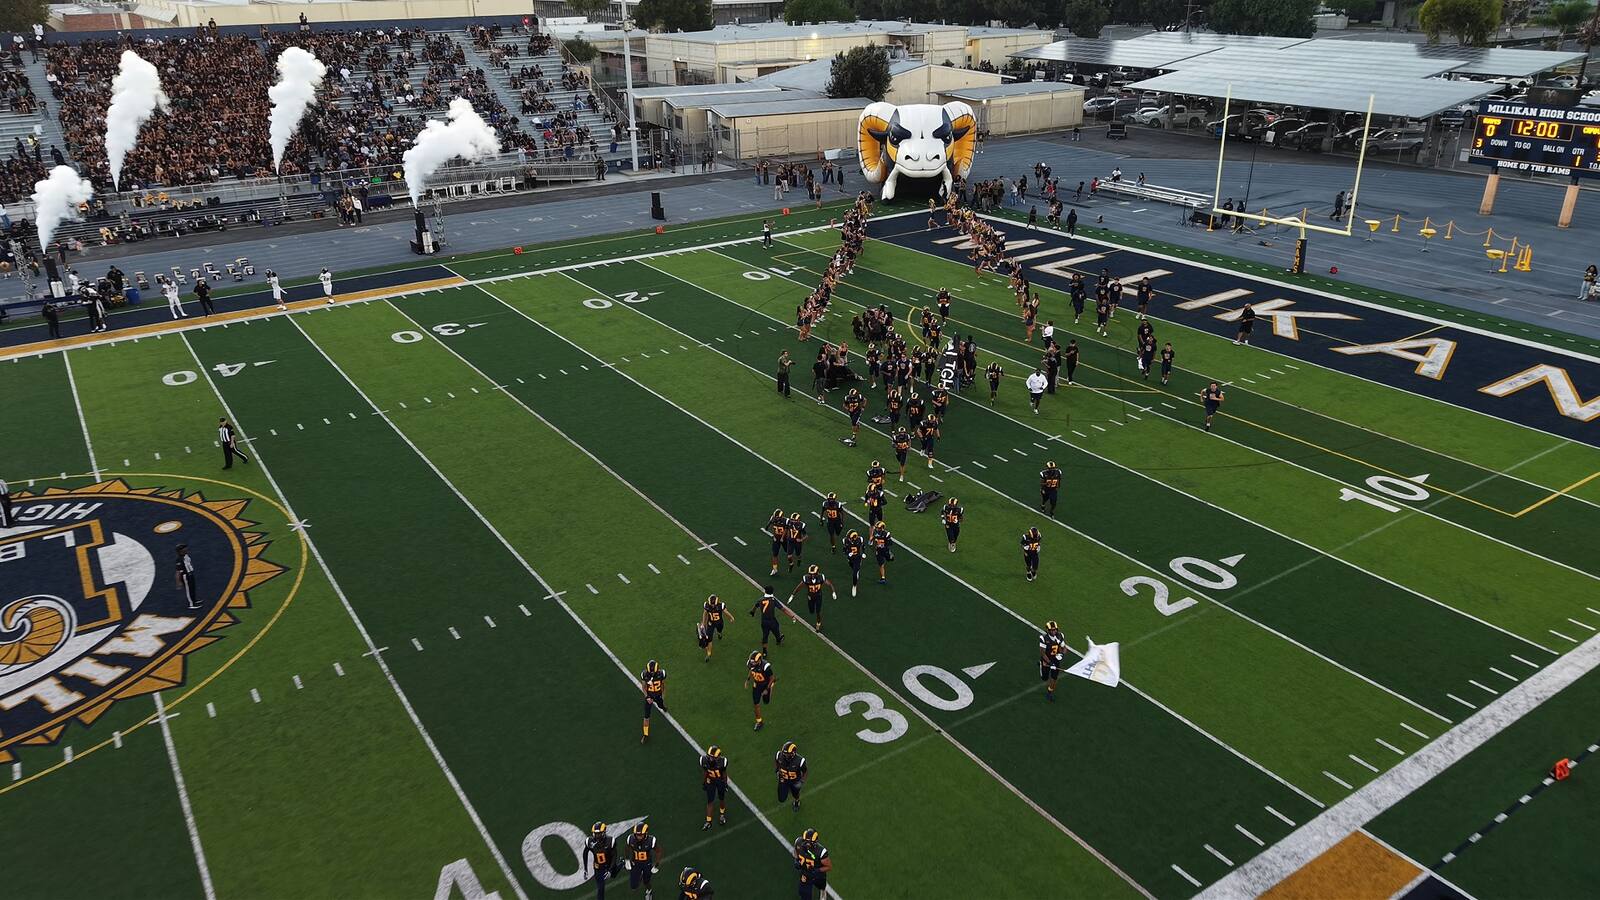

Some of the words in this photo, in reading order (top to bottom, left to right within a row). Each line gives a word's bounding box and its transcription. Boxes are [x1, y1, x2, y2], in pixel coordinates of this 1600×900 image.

[1488, 104, 1538, 116] MILLIKAN
[1540, 110, 1565, 118] HIGH
[1486, 125, 1496, 136] 0
[1517, 120, 1558, 138] 12:00
[1476, 138, 1483, 148] 3
[1490, 138, 1508, 146] DOWN
[1575, 156, 1580, 166] 1
[1547, 166, 1570, 175] RAMS
[1292, 240, 1302, 274] RAMS
[930, 230, 1600, 423] MILLIKAN
[1340, 475, 1430, 513] 10
[1120, 556, 1239, 617] 20
[762, 598, 770, 613] 7
[835, 664, 974, 744] 30
[596, 852, 606, 864] 0
[634, 851, 648, 861] 18
